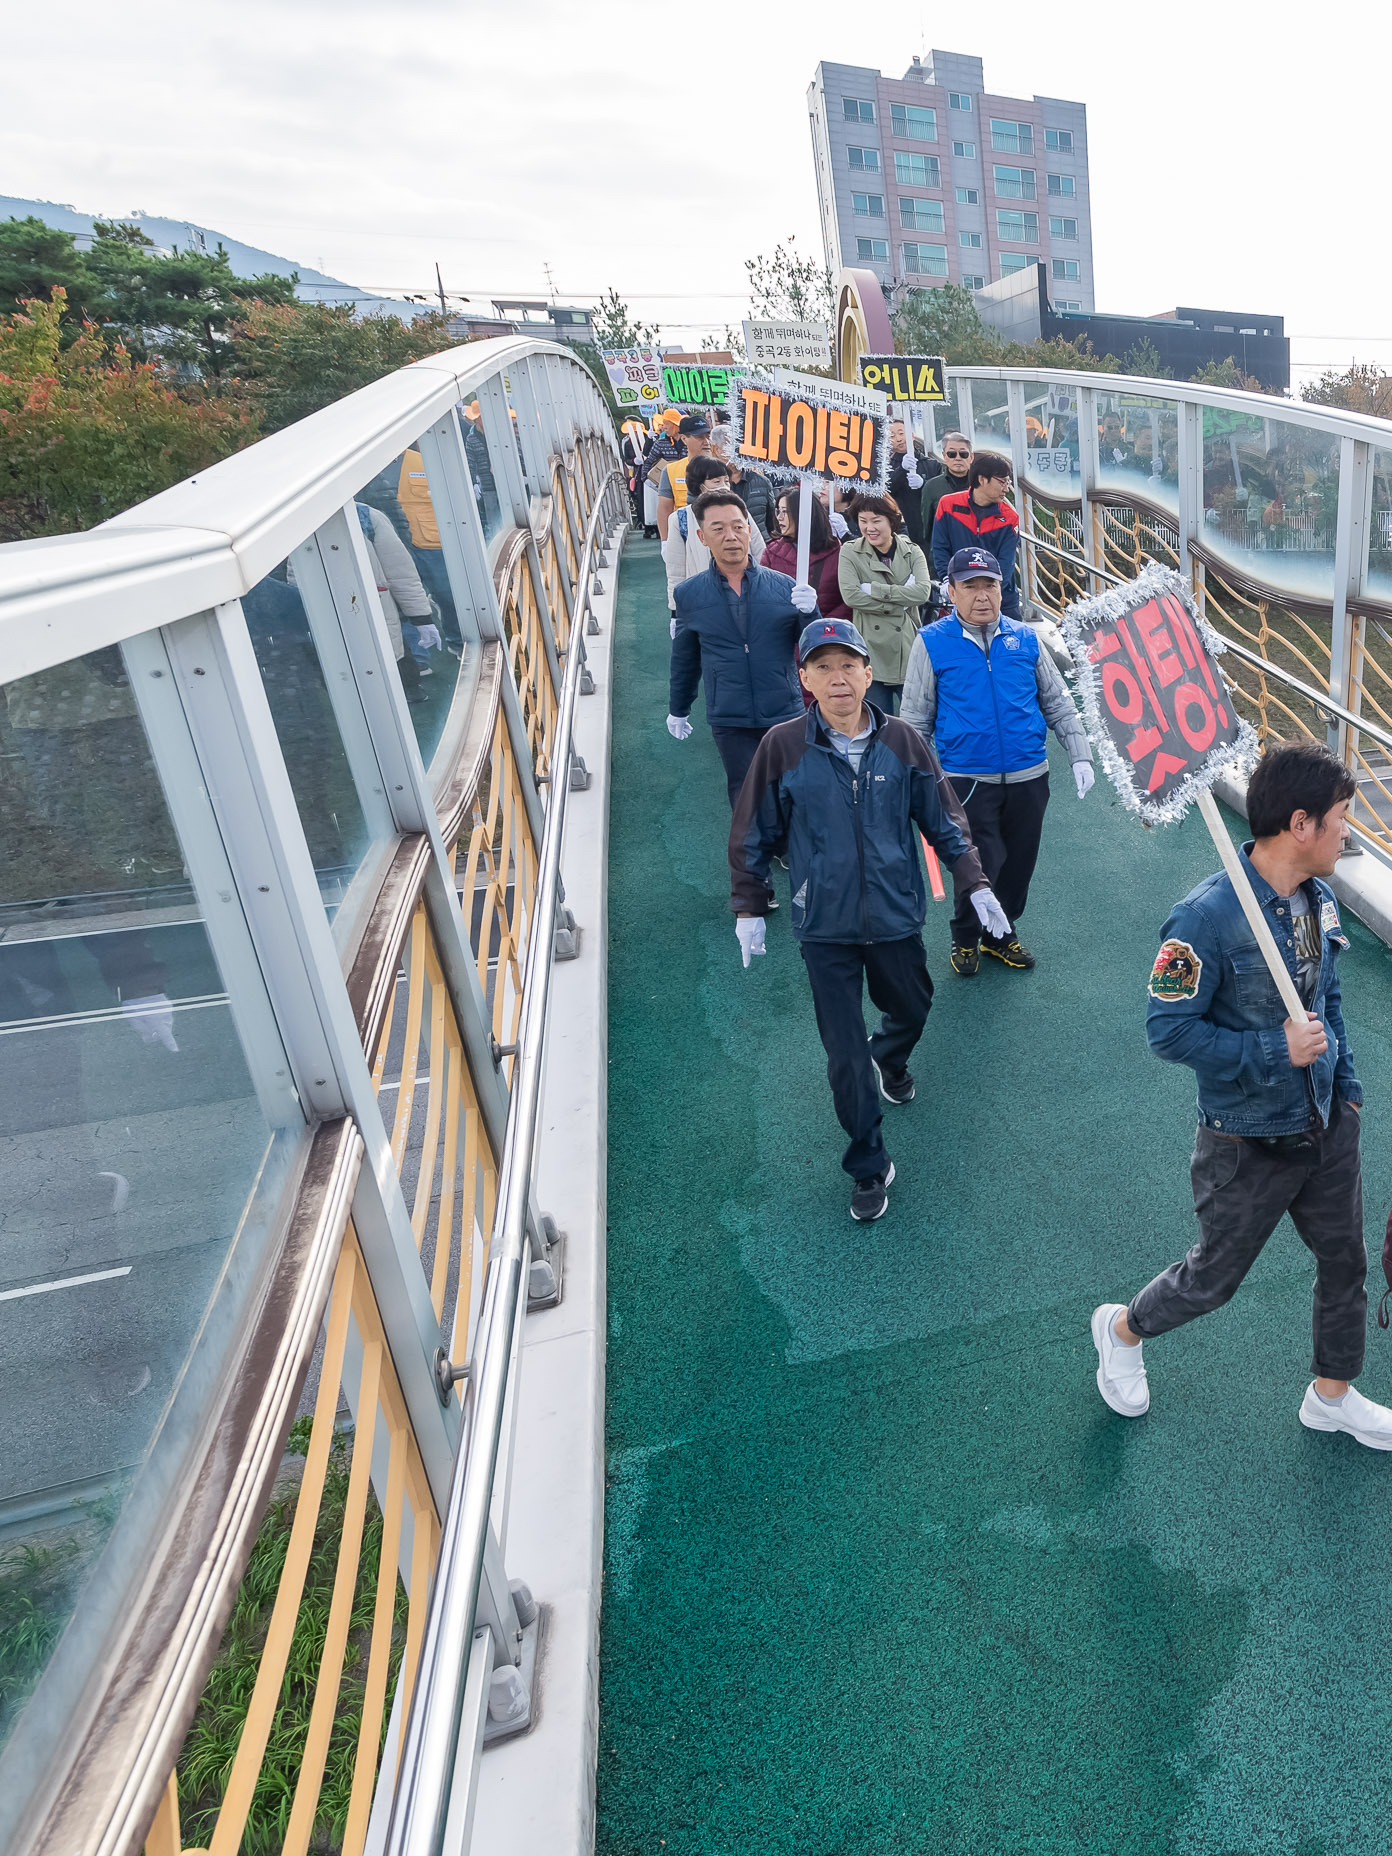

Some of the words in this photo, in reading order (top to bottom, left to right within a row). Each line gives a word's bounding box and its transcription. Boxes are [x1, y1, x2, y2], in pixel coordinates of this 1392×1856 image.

[752, 327, 774, 340] 함께
[755, 345, 792, 358] 중곡2동
[625, 364, 659, 382] 핑크
[663, 368, 745, 404] 에어로
[863, 364, 944, 400] 언니쓰
[739, 388, 873, 481] 파이팅!
